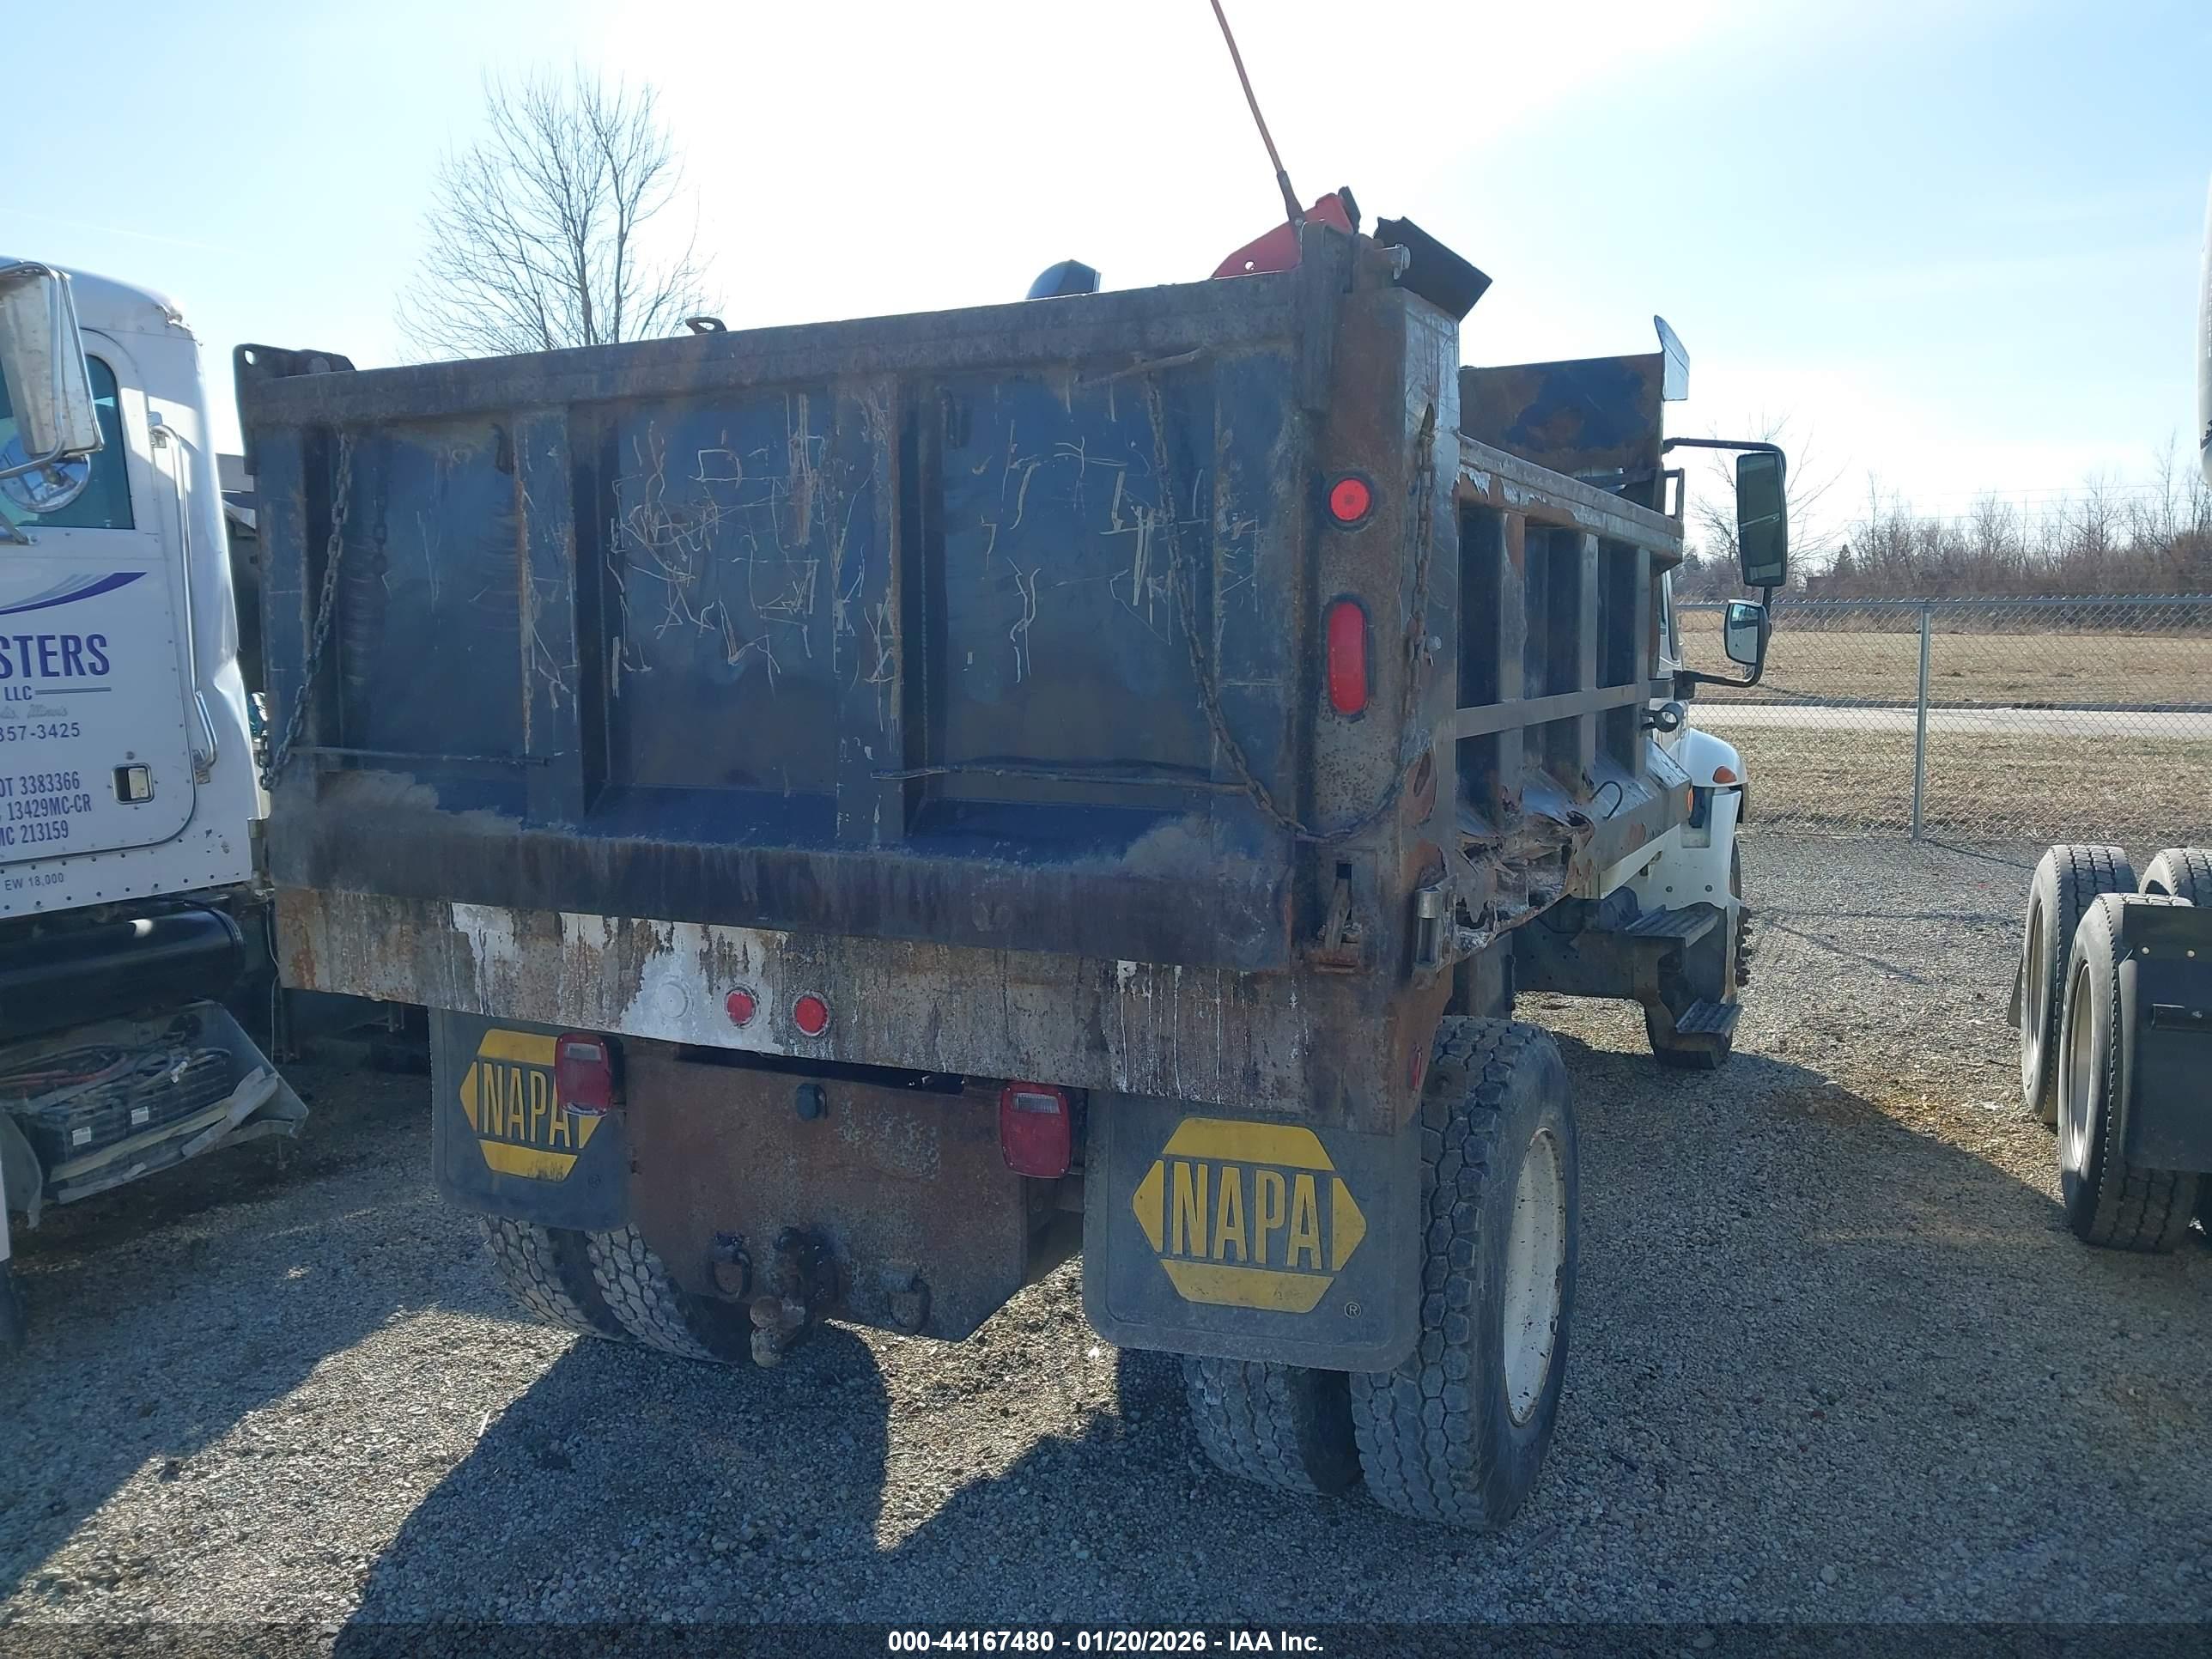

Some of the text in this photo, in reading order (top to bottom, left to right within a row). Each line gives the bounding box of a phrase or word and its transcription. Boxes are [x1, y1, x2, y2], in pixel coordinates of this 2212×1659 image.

[4, 685, 33, 702] LLC
[19, 770, 81, 795] 3383366
[7, 793, 92, 821] 13429MC-CR
[20, 819, 69, 844] 213159
[4, 878, 24, 890] EW
[483, 1063, 571, 1148] NAPA
[1172, 1161, 1322, 1271] NAPA
